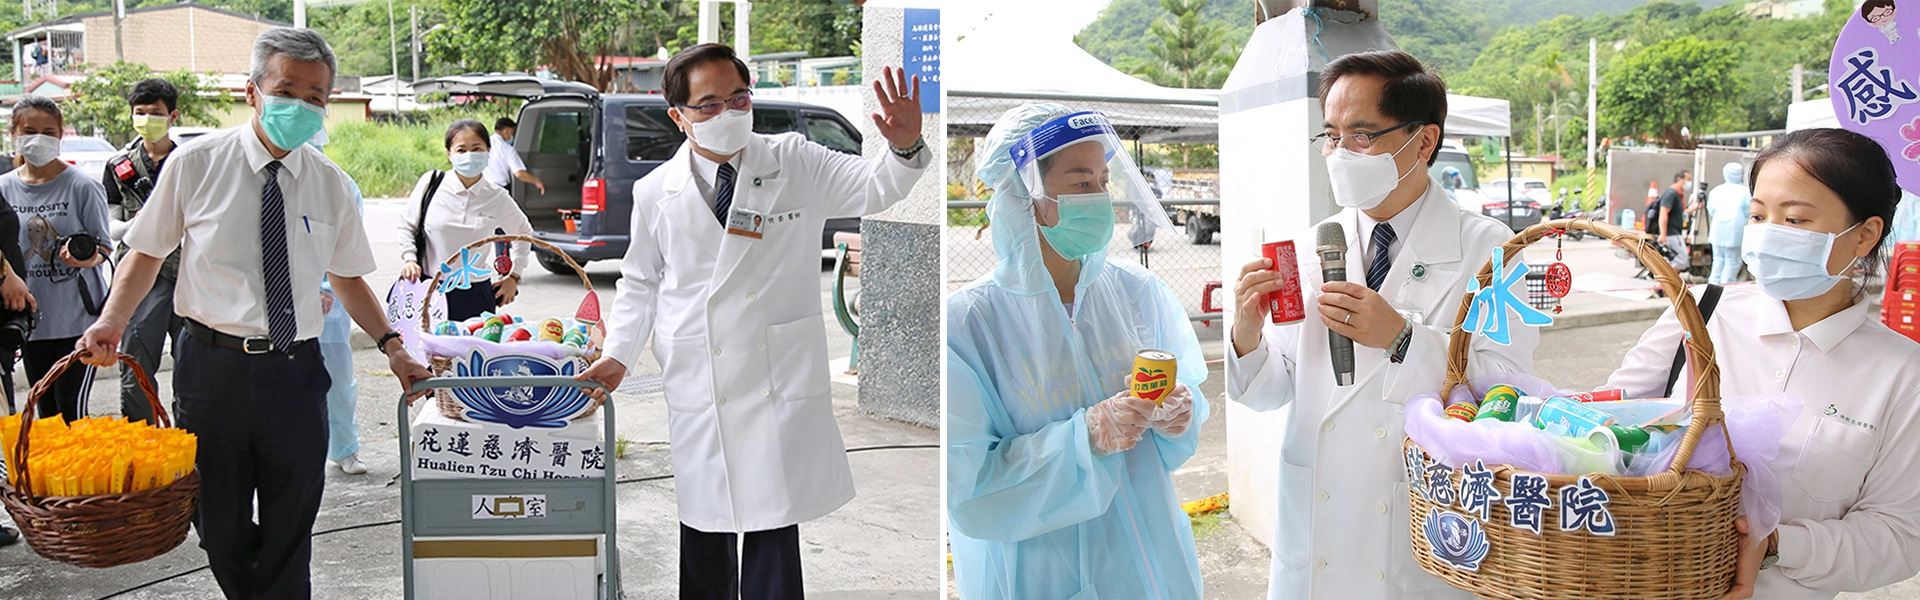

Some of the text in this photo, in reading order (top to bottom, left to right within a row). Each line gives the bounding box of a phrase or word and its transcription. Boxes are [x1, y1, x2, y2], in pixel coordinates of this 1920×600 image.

[1838, 51, 1917, 123] 感
[1072, 116, 1093, 127] Face
[12, 202, 69, 214] CURIOSITY
[438, 248, 492, 293] 冰
[1462, 247, 1553, 344] 冰
[418, 428, 606, 470] 花蓮慈濟醫院
[417, 457, 475, 474] Hualien
[479, 464, 507, 478] Tzu
[512, 467, 538, 479] Chi
[474, 496, 546, 518] 人室
